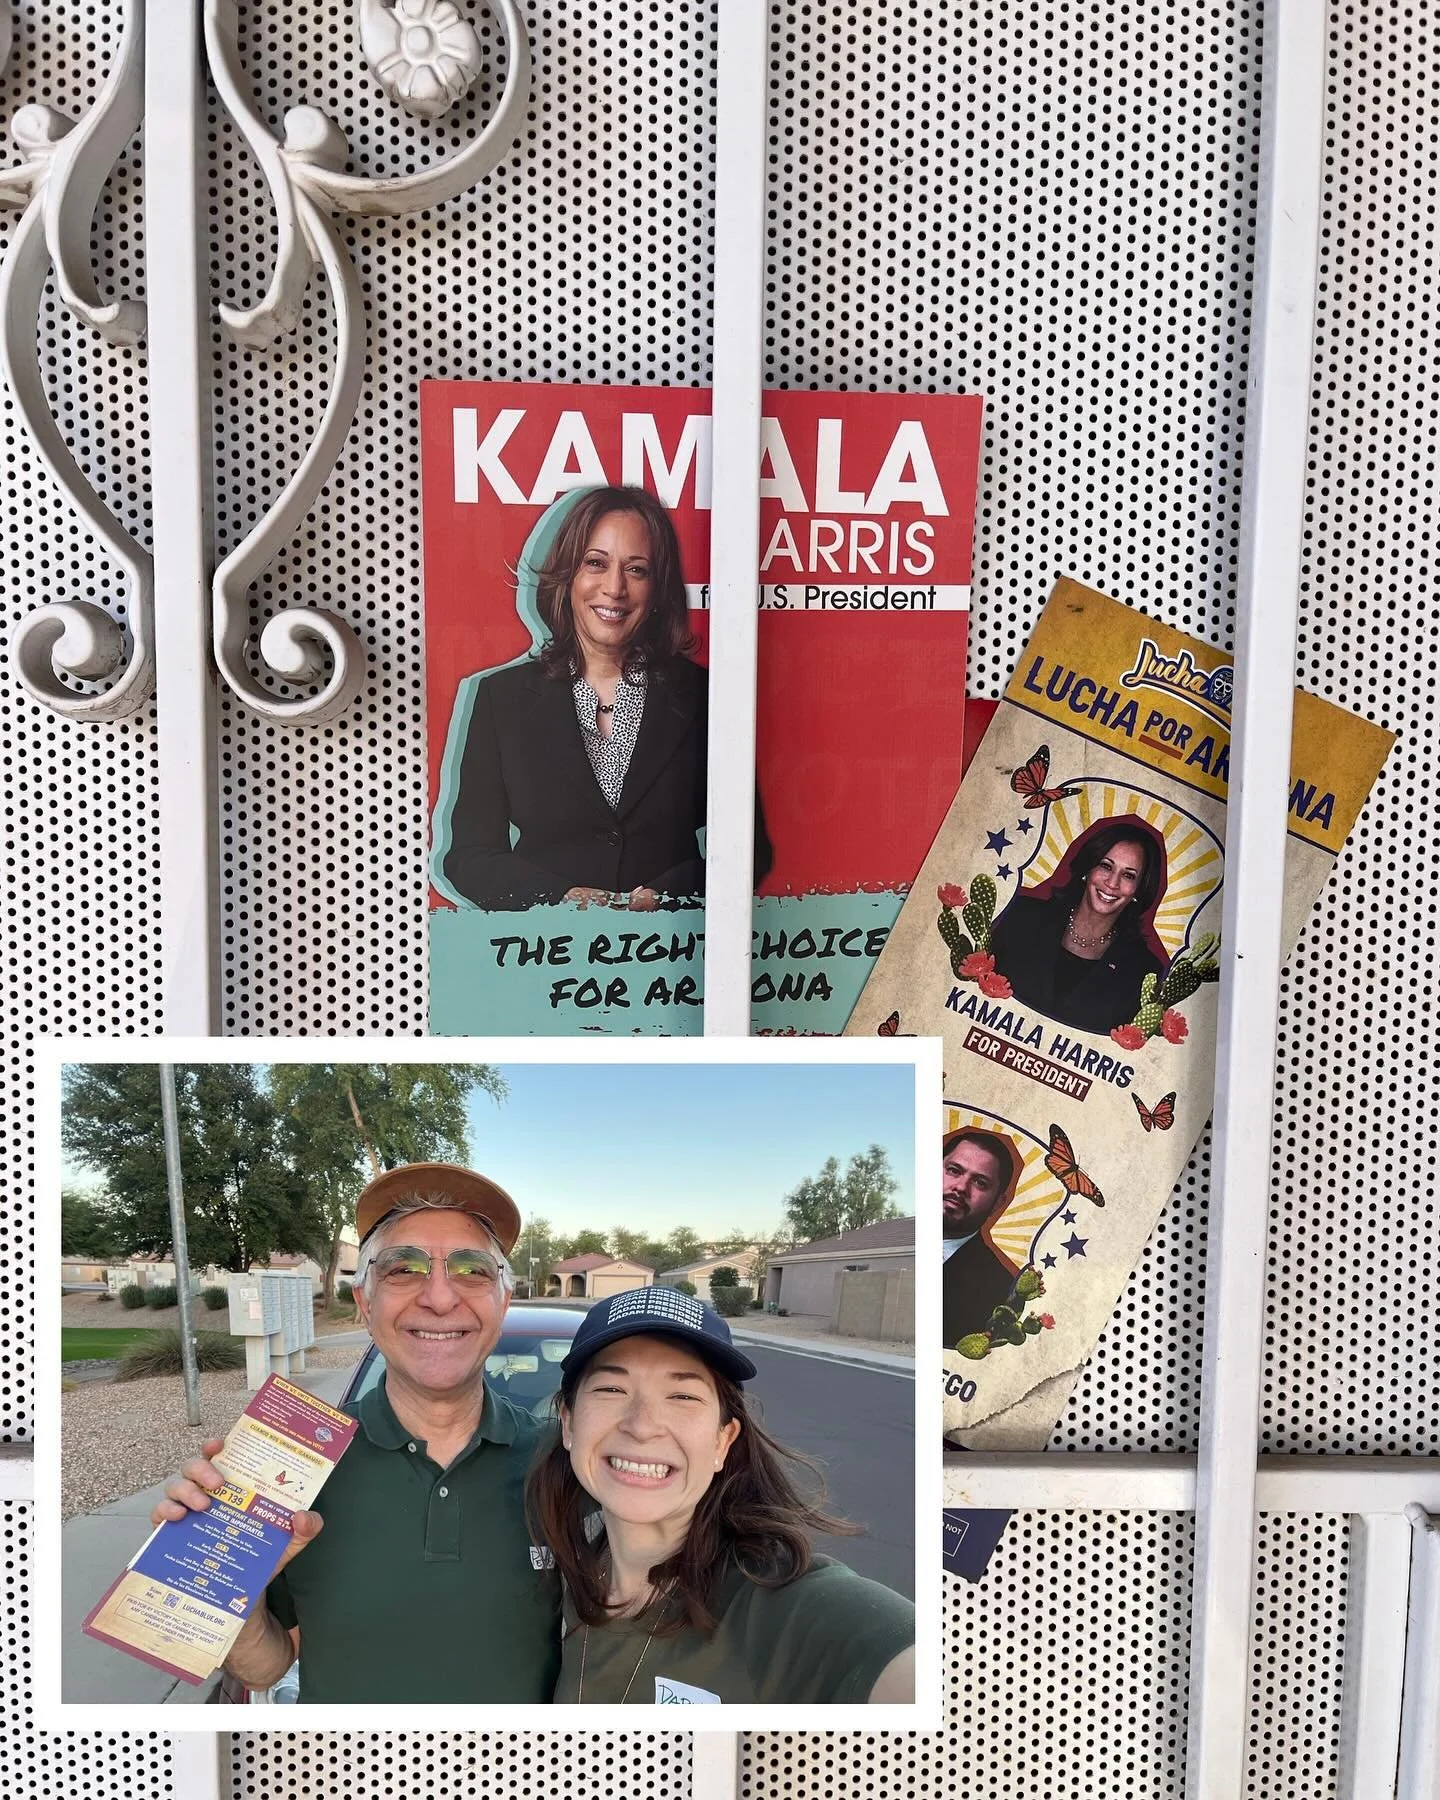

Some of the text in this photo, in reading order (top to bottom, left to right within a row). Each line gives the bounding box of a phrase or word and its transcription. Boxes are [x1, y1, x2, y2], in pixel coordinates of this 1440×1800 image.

[760, 519, 936, 576] ARRIS
[805, 585, 937, 611] President
[1122, 639, 1208, 696] Lucha
[1024, 655, 1336, 830] LUCHA POR ARNA
[490, 926, 890, 967] THE RIGH HOICE
[549, 971, 834, 1009] FOR ARONA
[944, 986, 1135, 1089] KAMALA HARRIS
[967, 1031, 1088, 1097] FOR PRESIDENT
[608, 1305, 703, 1326] MADAM PRESIDENT
[609, 1300, 703, 1320] MADAM PRESIDENT
[649, 1295, 704, 1314] PRESIDENT
[607, 1310, 702, 1330] MADAM PRESIDENT
[228, 1492, 243, 1506] 139
[210, 1508, 230, 1521] FECHAS
[230, 1517, 264, 1537] IMPORTANTES
[219, 1504, 246, 1521] IMPORTANT
[252, 1505, 277, 1523] PROPS
[945, 1523, 962, 1535] NOT
[229, 1600, 243, 1611] VOTE
